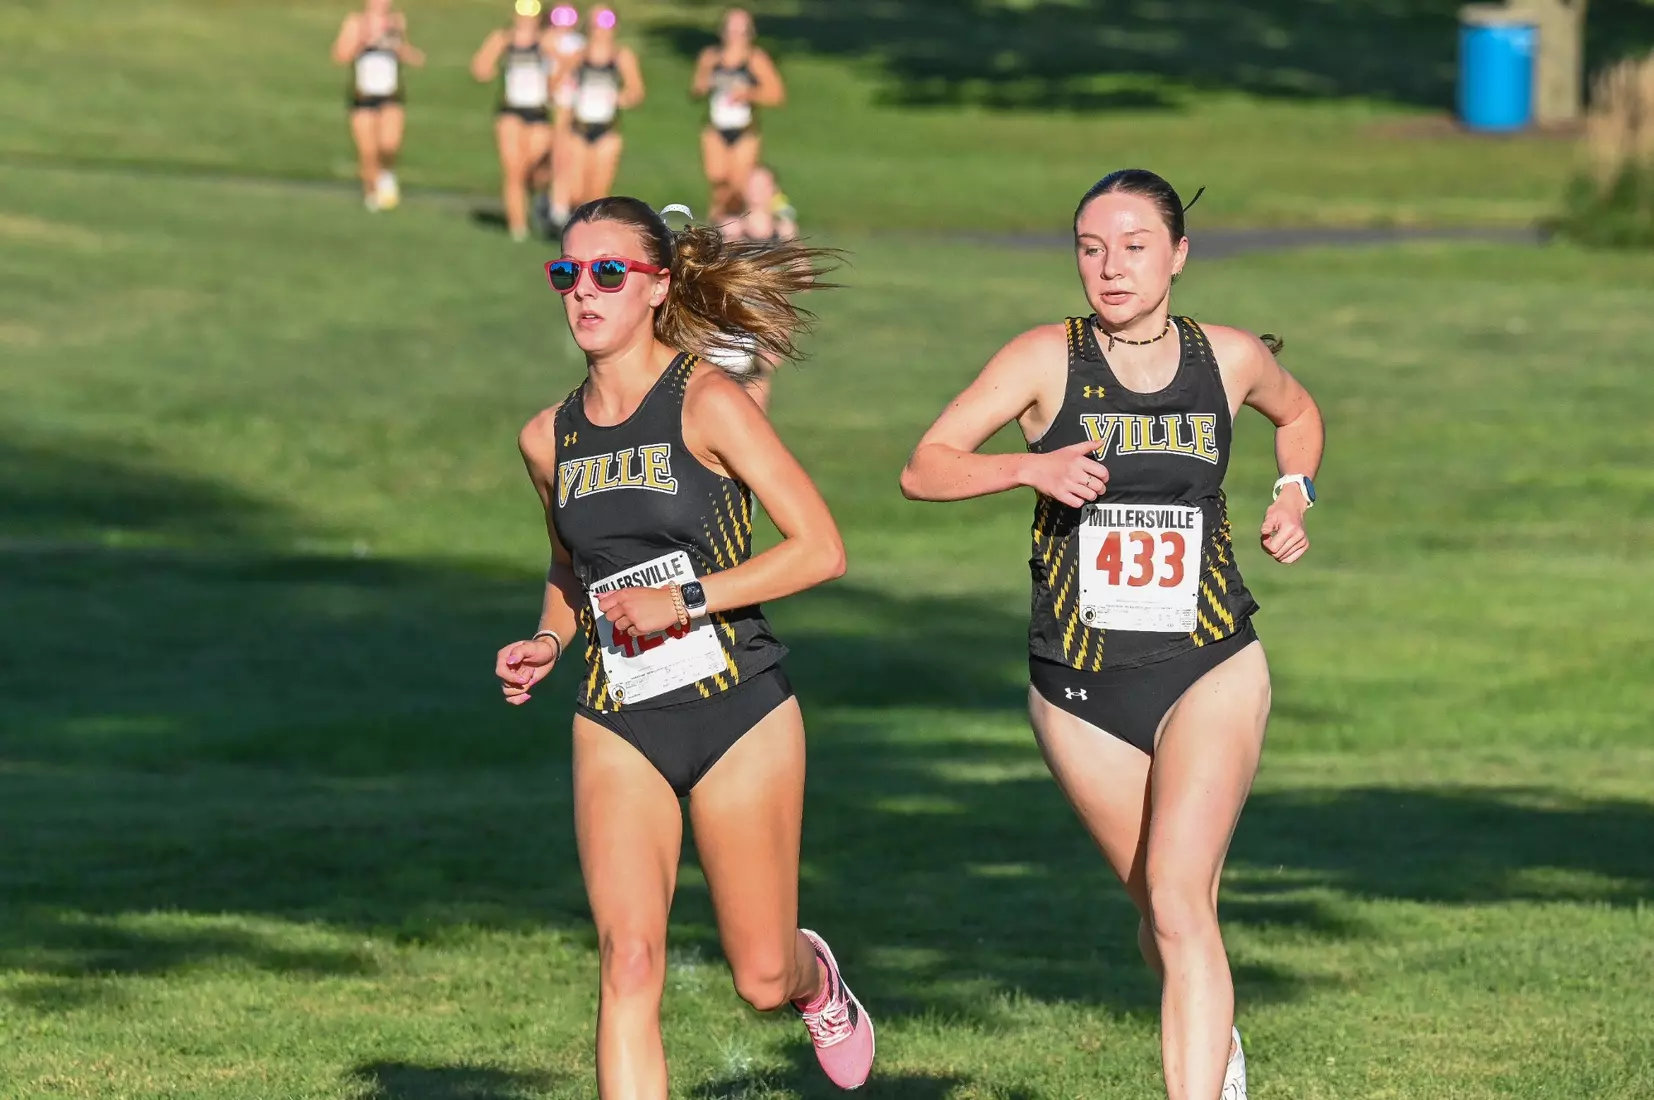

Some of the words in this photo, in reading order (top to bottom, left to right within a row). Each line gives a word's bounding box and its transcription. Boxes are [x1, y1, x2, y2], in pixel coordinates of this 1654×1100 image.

[1080, 413, 1219, 465] VILLE
[558, 443, 678, 508] VILLE
[1088, 508, 1194, 530] MILLERSVILLE
[1095, 530, 1186, 588] 433
